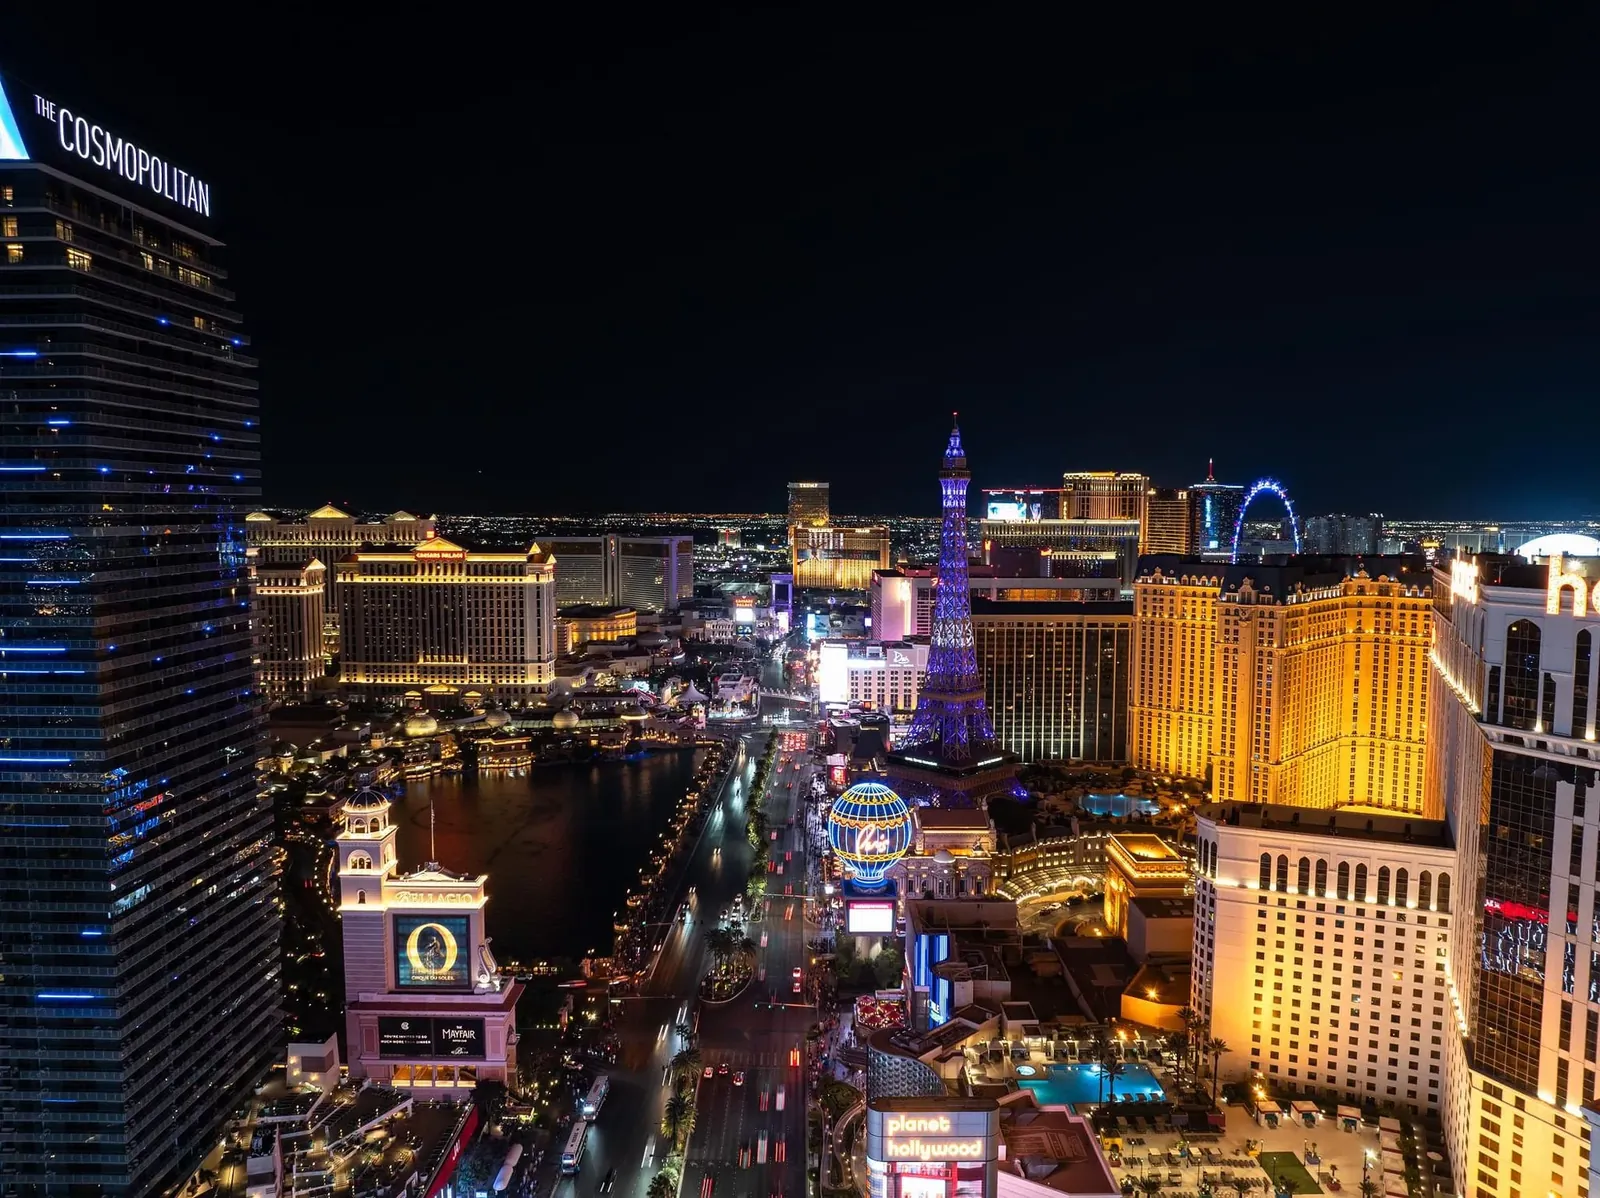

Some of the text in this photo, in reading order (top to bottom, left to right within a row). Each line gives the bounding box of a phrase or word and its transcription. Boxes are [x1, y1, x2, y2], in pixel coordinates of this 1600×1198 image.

[34, 93, 210, 217] THE COSMOPOLITAN
[395, 890, 473, 904] BELLAGIO
[406, 923, 458, 974] O
[442, 1028, 476, 1040] MAYFAIR
[888, 1115, 950, 1136] planet
[888, 1140, 982, 1160] hollywood
